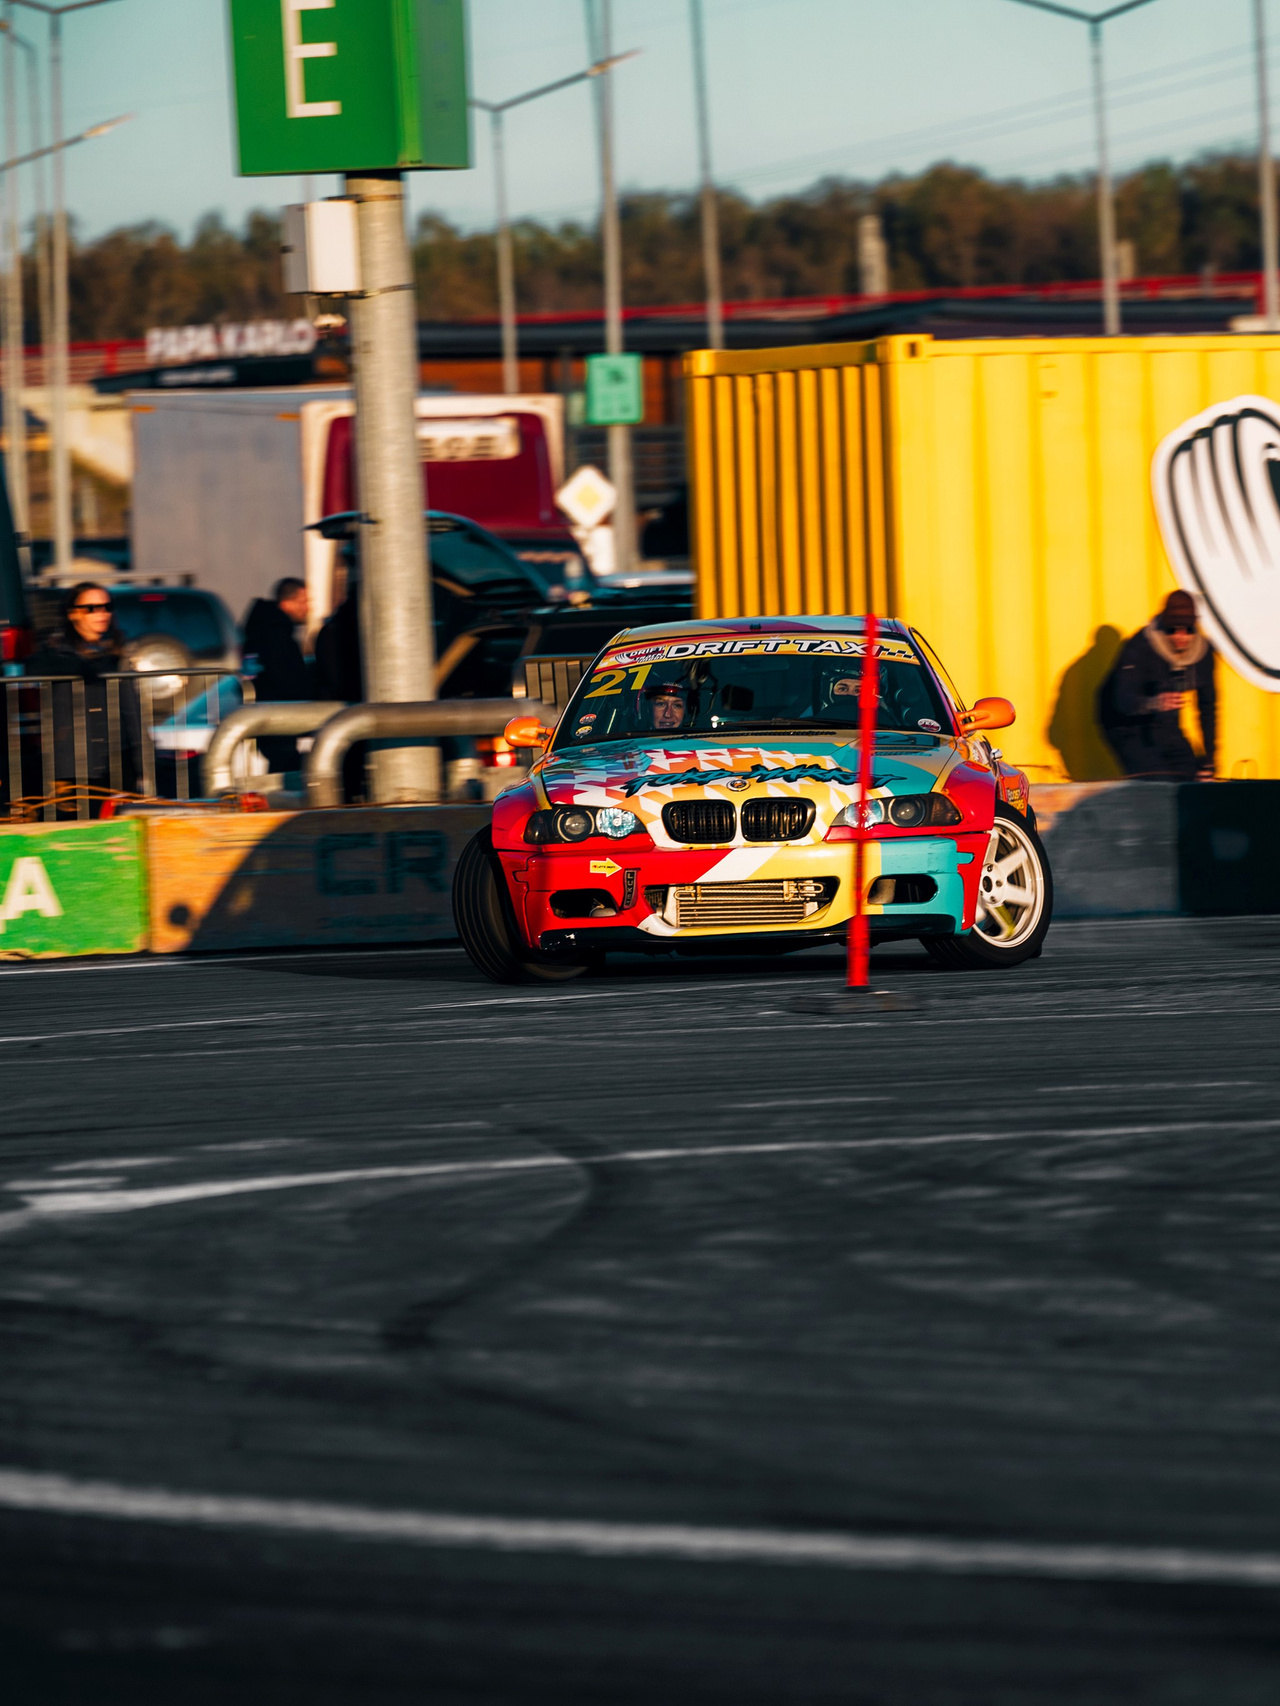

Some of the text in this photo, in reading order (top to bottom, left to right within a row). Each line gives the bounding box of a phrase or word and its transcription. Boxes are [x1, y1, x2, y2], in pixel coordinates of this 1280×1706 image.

[282, 0, 342, 118] E
[666, 639, 787, 659] DRIFT
[583, 664, 653, 699] 21
[0, 857, 63, 922] A
